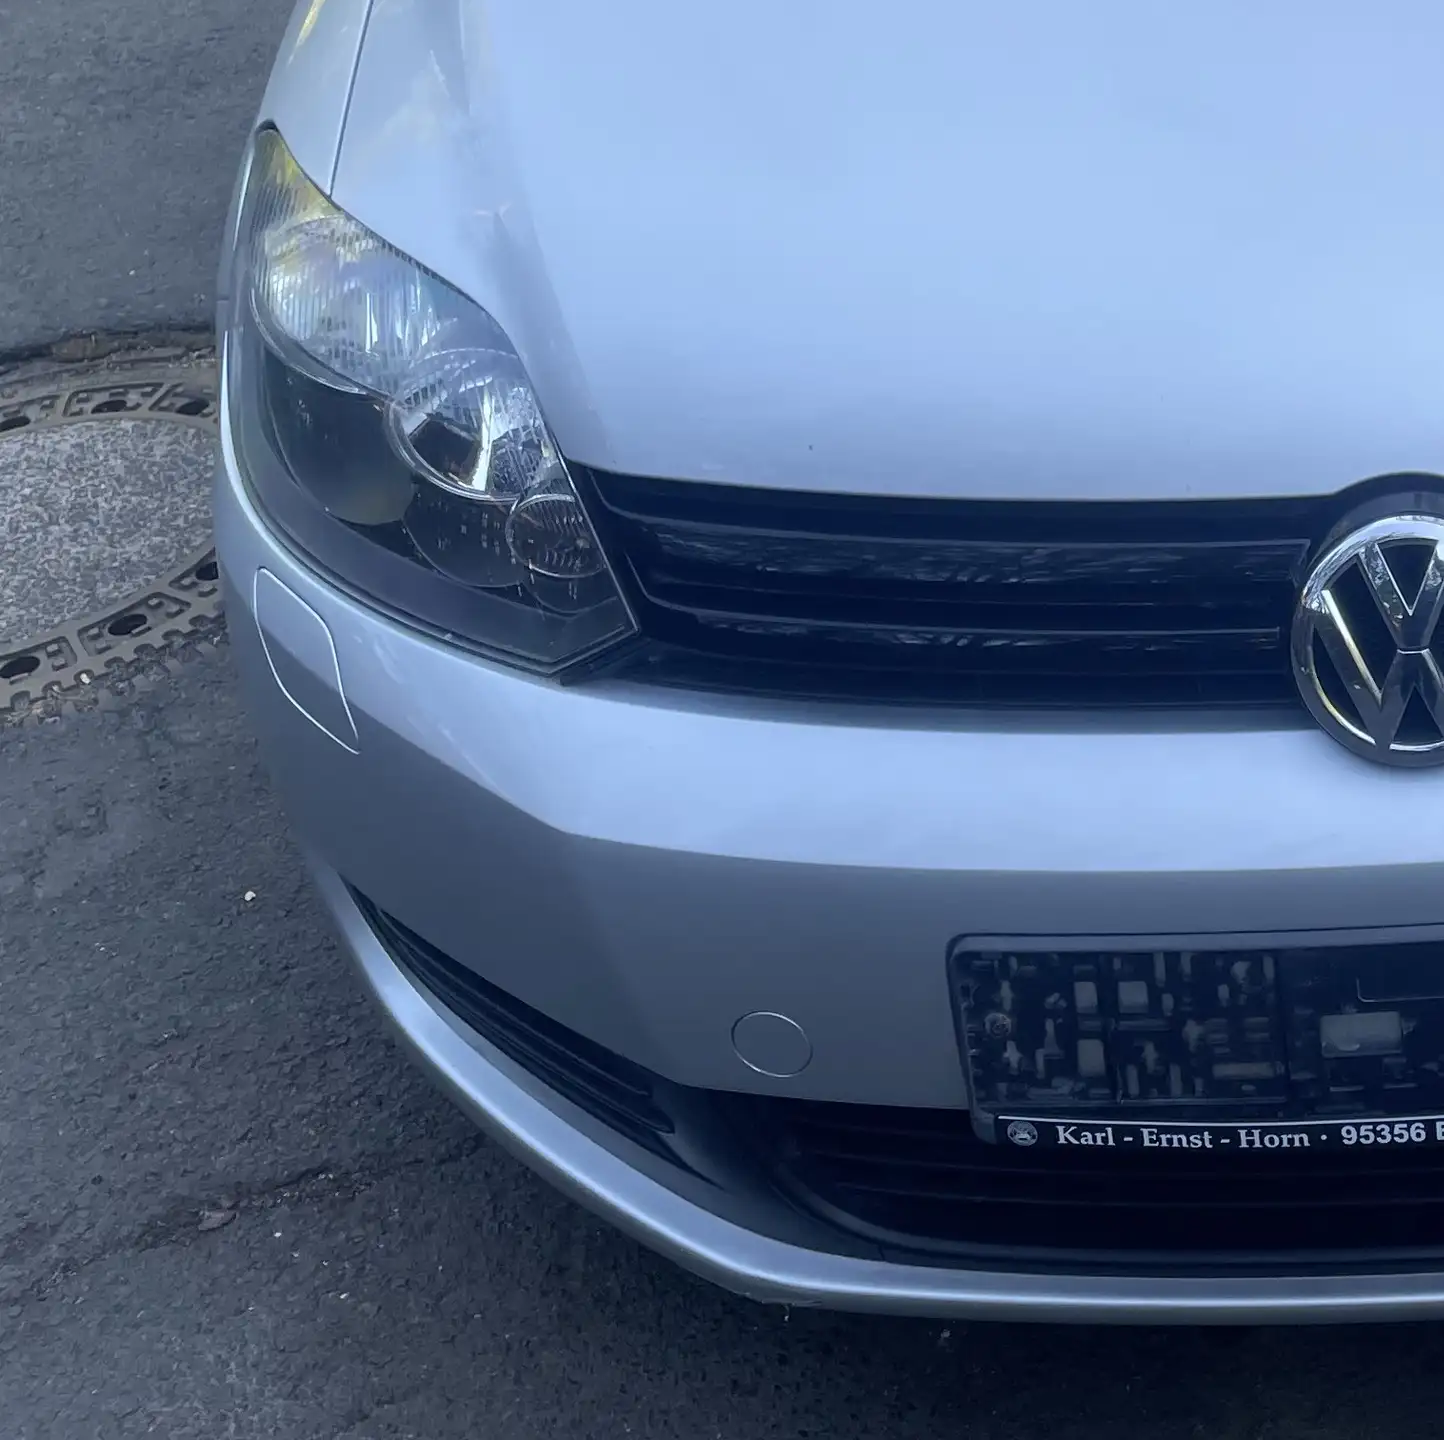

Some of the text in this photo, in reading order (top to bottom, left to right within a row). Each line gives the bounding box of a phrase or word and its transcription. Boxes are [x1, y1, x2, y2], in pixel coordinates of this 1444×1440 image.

[1055, 1125, 1116, 1146] Karl
[1139, 1127, 1213, 1149] Ernst
[1237, 1128, 1311, 1148] Horn
[1340, 1122, 1427, 1145] 95356
